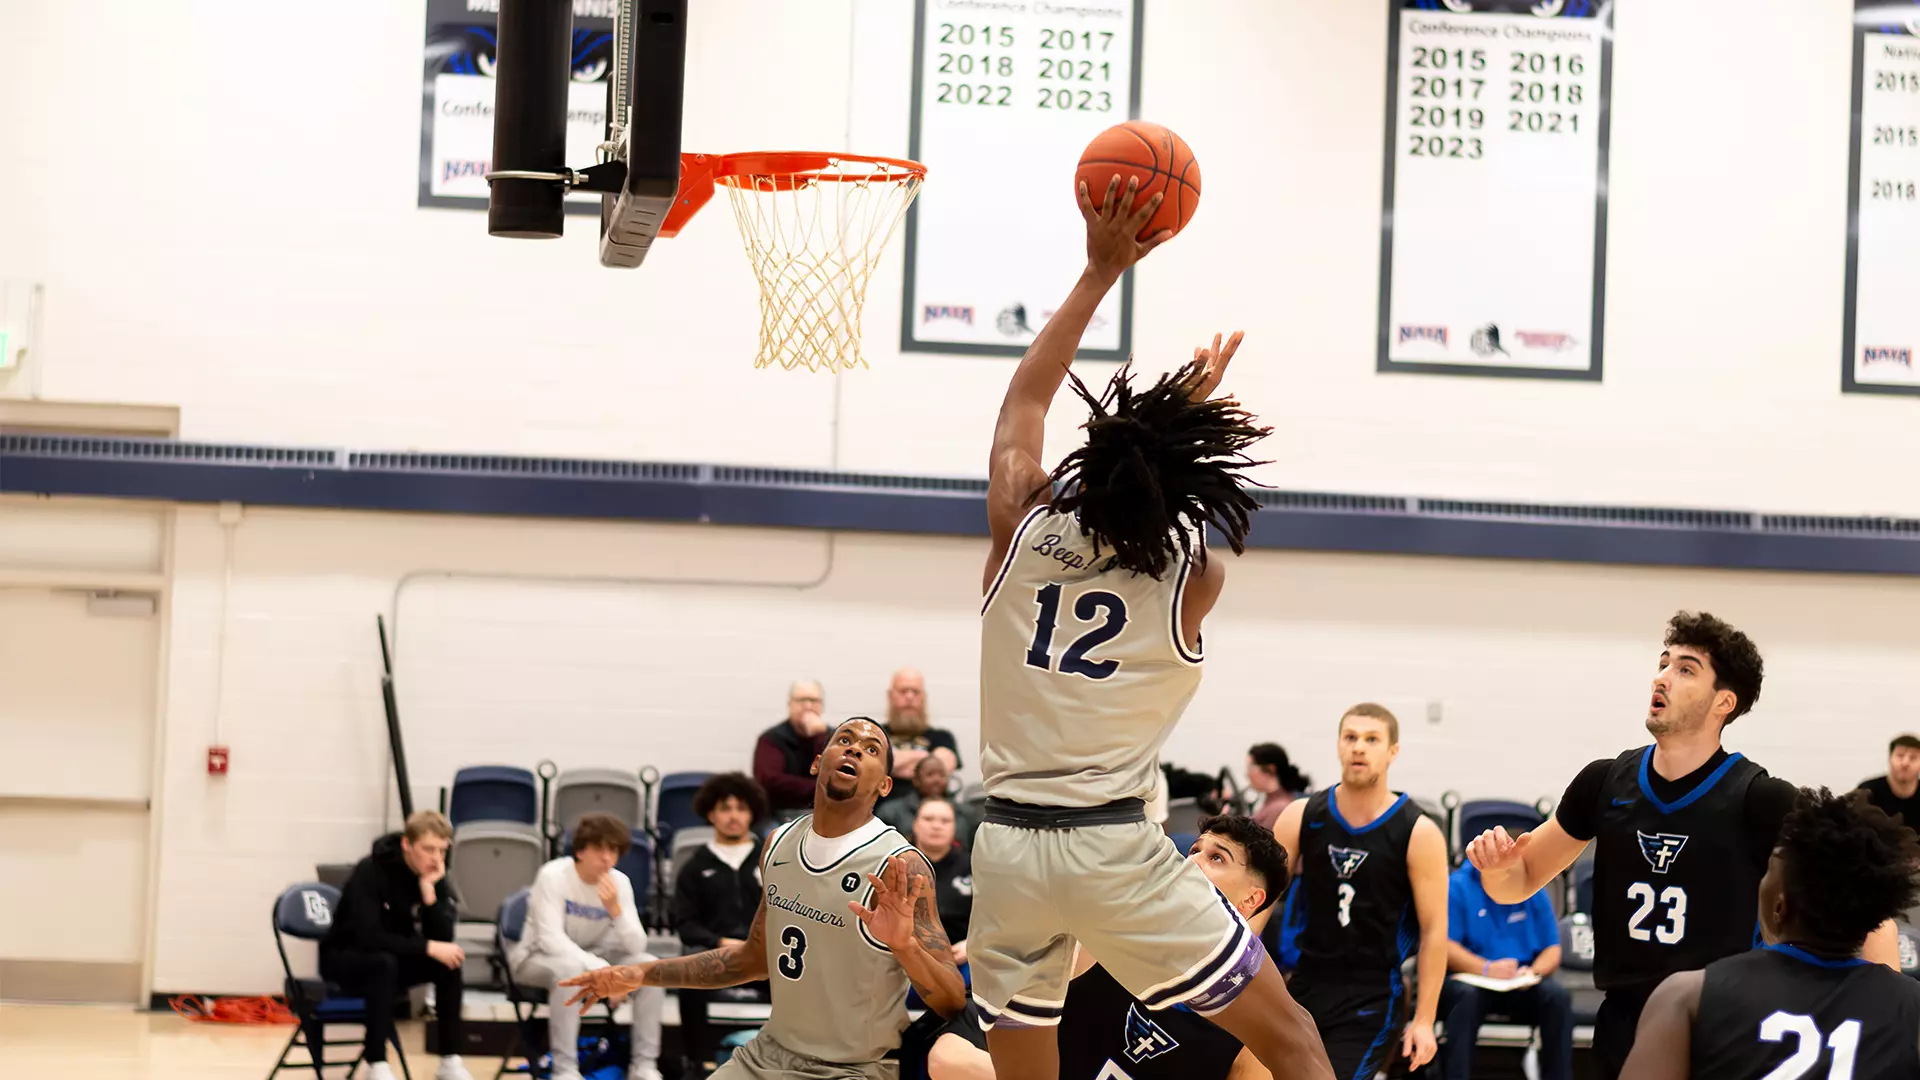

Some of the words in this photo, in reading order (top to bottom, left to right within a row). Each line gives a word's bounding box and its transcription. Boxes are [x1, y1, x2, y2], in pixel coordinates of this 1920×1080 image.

[940, 23, 1015, 48] 2015
[1039, 28, 1114, 52] 2017
[938, 53, 1014, 77] 2018
[1038, 58, 1111, 81] 2021
[1411, 47, 1487, 71] 2015
[1510, 52, 1585, 76] 2016
[937, 83, 1012, 107] 2022
[1037, 88, 1112, 112] 2023
[1410, 76, 1486, 99] 2017
[1510, 81, 1583, 104] 2018
[1410, 105, 1485, 129] 2019
[1508, 110, 1580, 134] 2021
[1409, 135, 1483, 159] 2023
[924, 305, 975, 326] NAIA
[1399, 325, 1448, 348] NAIA
[1032, 533, 1101, 572] Beep!
[1024, 582, 1132, 682] 12
[766, 883, 846, 929] Roadrunners
[1337, 883, 1356, 927] 3
[1627, 882, 1688, 944] 23
[778, 924, 809, 981] 3
[1758, 1010, 1862, 1080] 21
